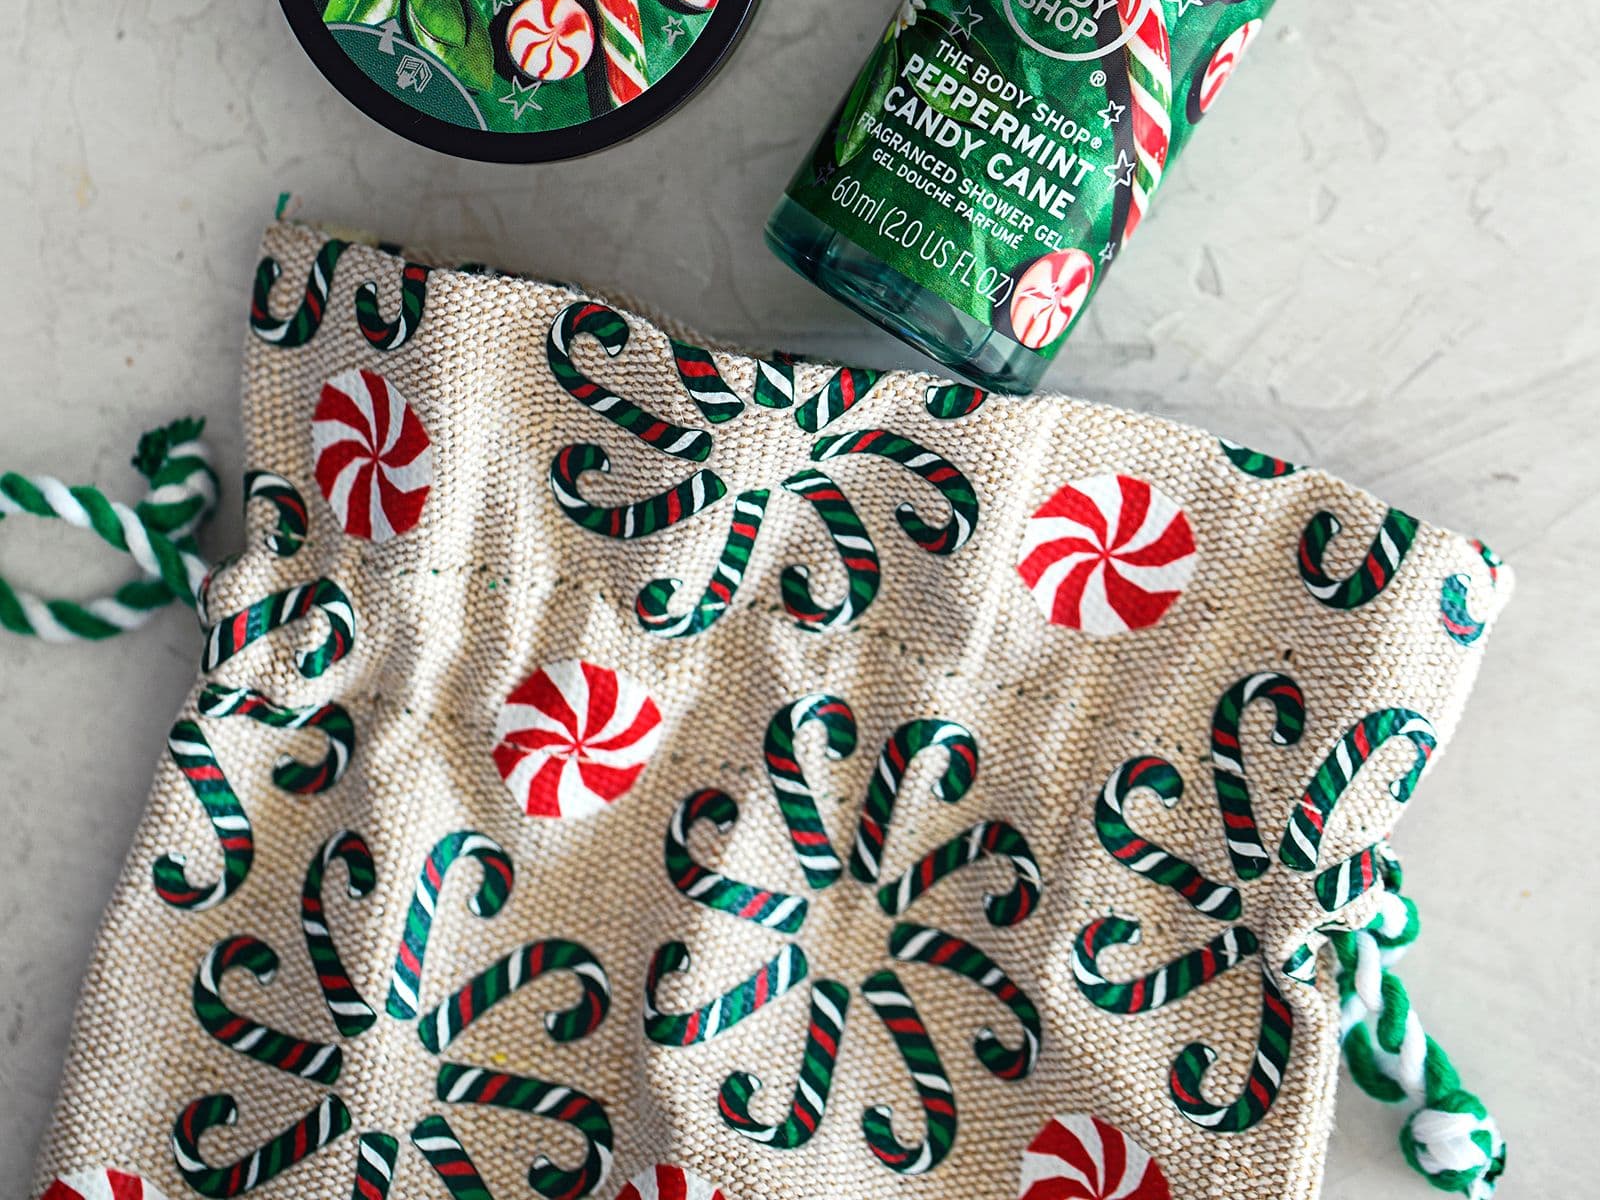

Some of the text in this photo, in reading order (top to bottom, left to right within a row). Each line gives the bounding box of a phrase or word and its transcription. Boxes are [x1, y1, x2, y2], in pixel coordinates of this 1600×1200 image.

[900, 54, 1096, 188] PEPPERMINT
[933, 39, 974, 75] THE
[972, 64, 1035, 110] BODY
[857, 111, 1064, 252] FRAGRANCED SHOWER GEL
[872, 148, 1024, 250] GEL DOUCHE PARFUMÉ
[883, 86, 1076, 221] CANDY CANE
[879, 206, 923, 248] (2.0
[919, 230, 955, 270] US
[950, 250, 973, 287] FL
[975, 266, 1016, 308] OZ)
